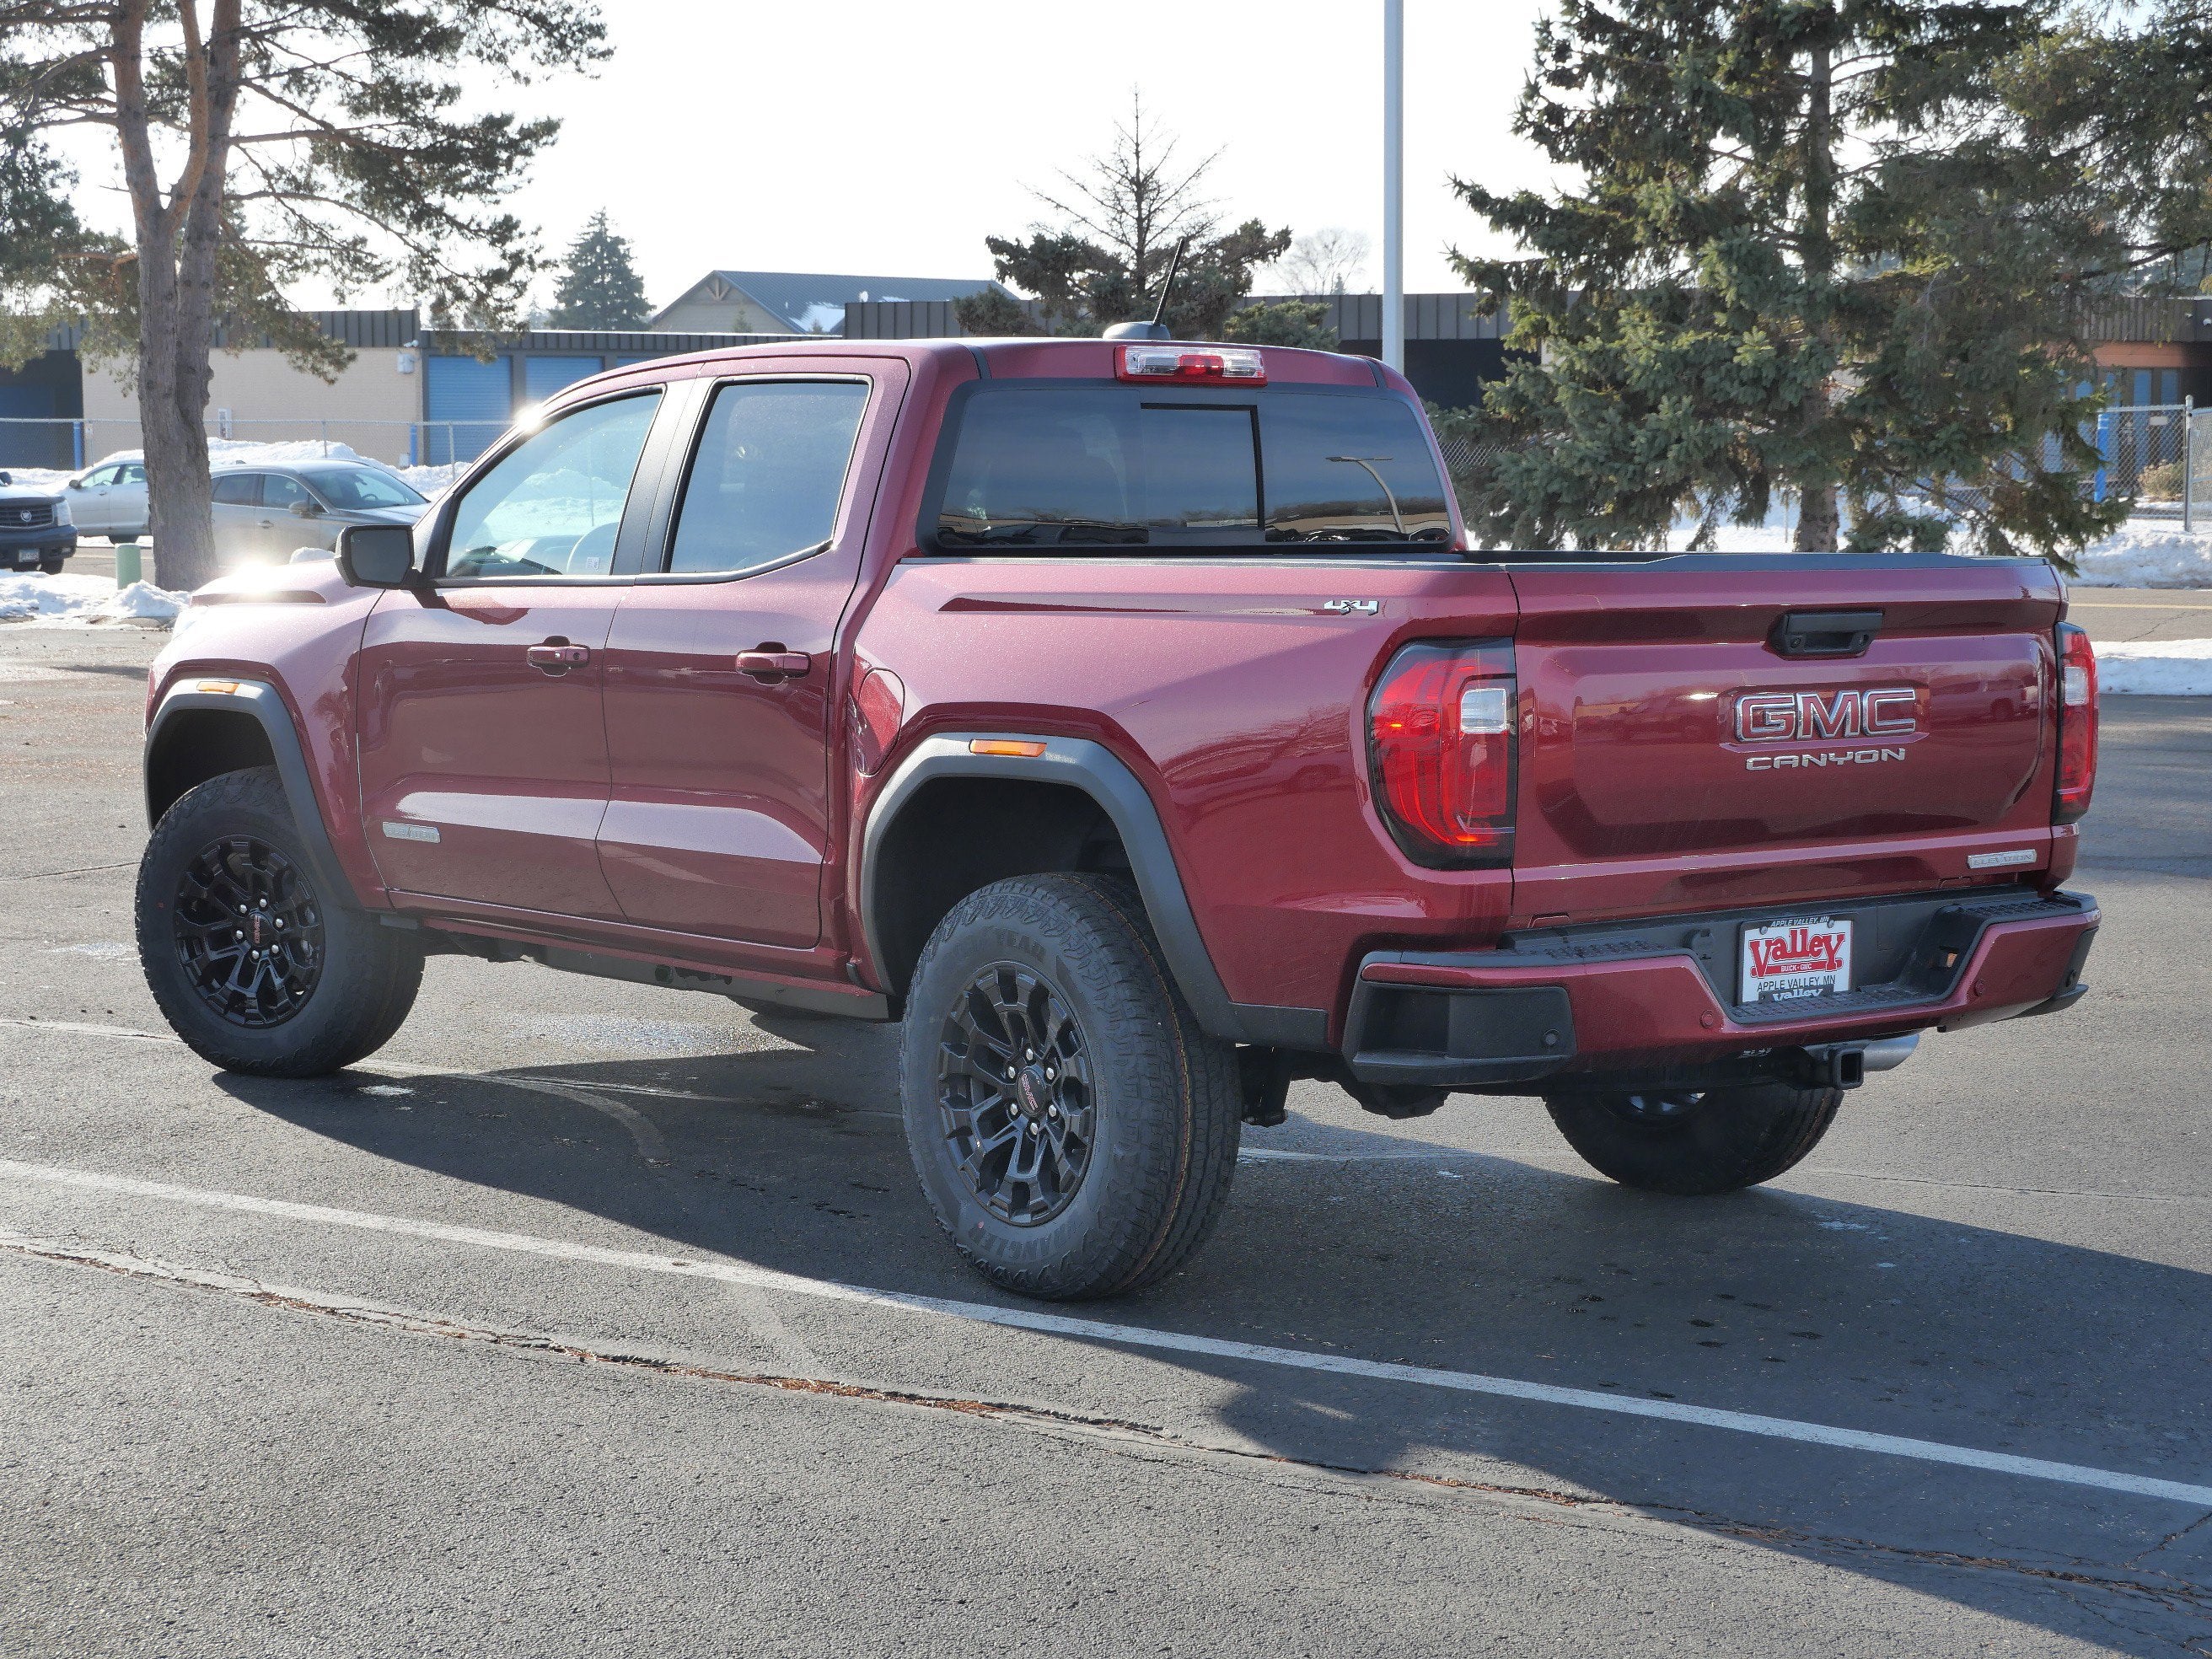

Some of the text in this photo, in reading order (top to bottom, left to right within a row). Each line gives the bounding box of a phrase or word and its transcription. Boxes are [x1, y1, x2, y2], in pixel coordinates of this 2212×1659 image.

[1734, 688, 1916, 744] GMC
[1745, 748, 1906, 771] CANYON
[1770, 919, 1793, 927] APPLE
[1780, 963, 1812, 973] BUICK GMC
[1757, 980, 1785, 992] APPLE
[1823, 974, 1836, 985] MN
